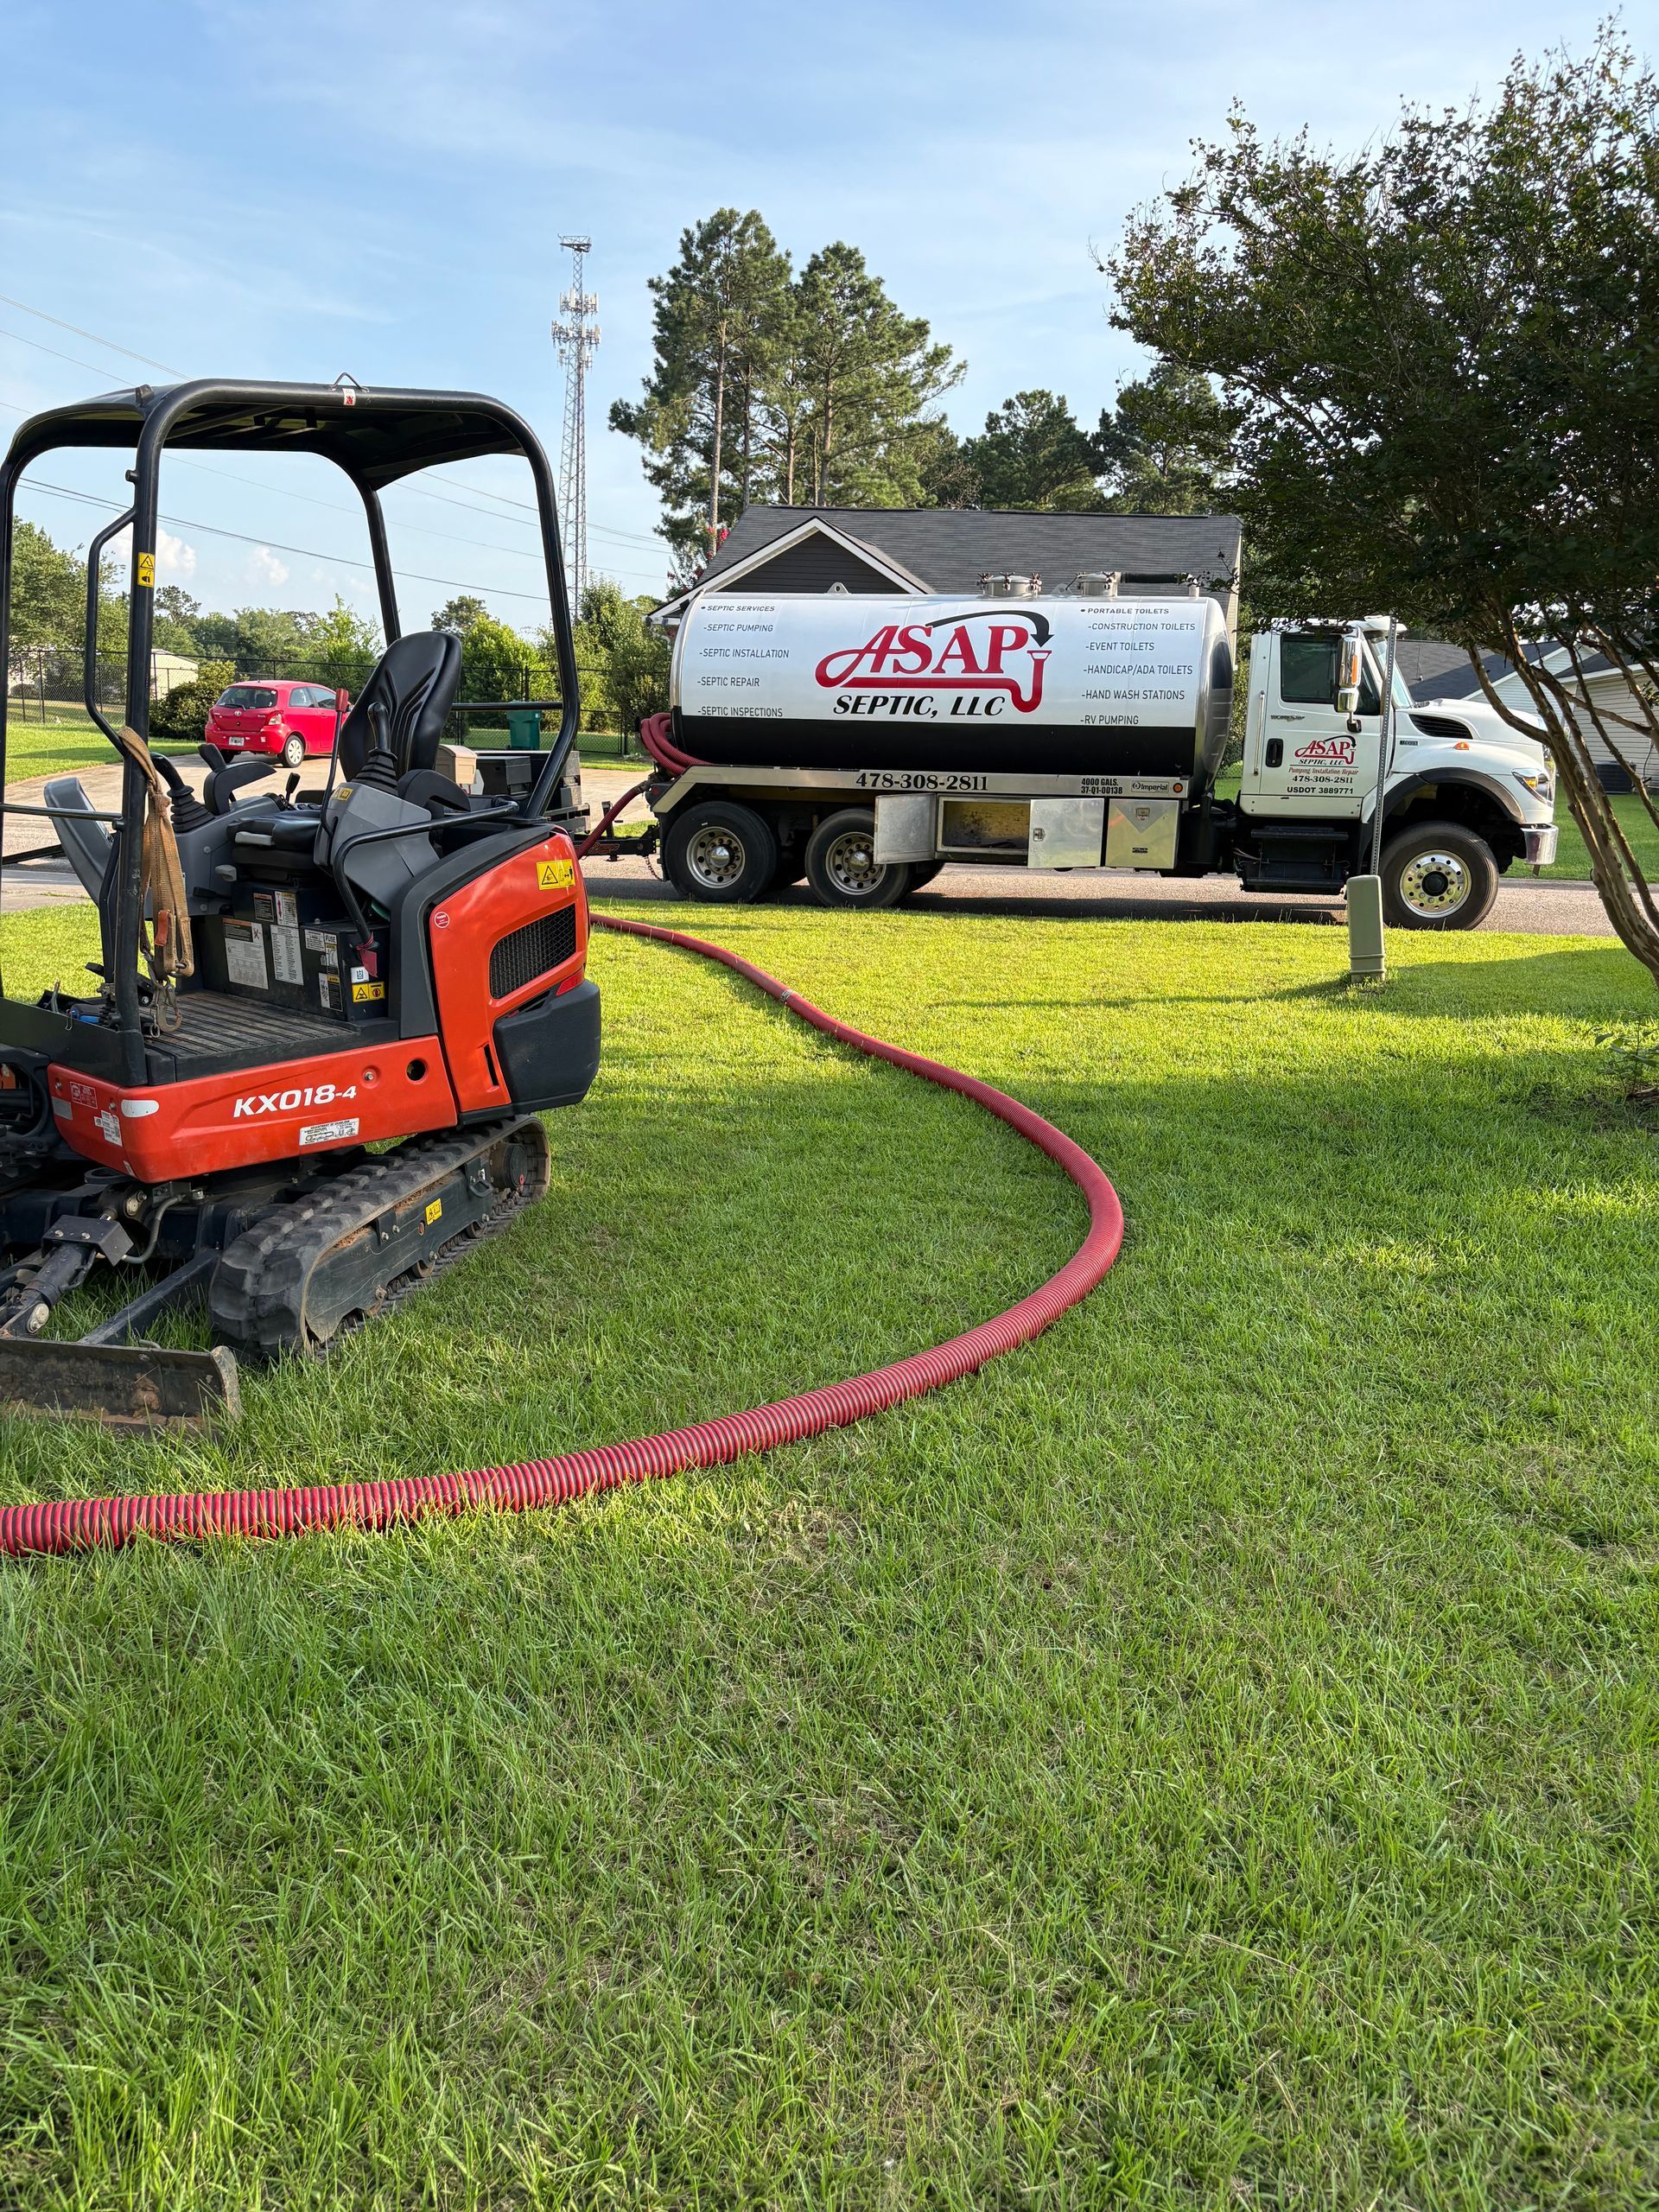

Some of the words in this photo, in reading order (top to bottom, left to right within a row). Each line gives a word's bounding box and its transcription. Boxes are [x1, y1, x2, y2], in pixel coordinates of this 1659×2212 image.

[1120, 642, 1154, 651] TOILETS
[733, 649, 790, 658] INSTALLATION
[815, 625, 1029, 688] ASAP
[1084, 664, 1155, 676] -HANDICAP/ADA
[1158, 664, 1193, 675] TOILETS
[730, 677, 760, 687] REPAIR
[1081, 690, 1111, 700] -HAND
[1113, 690, 1140, 700] WASH
[1141, 690, 1185, 700] STATIONS
[833, 695, 938, 718] SEPTIC,
[950, 696, 1006, 716] LLC
[730, 707, 783, 717] INSPECTIONS
[1098, 715, 1139, 725] PUMPING
[1294, 740, 1351, 758] ASAP
[855, 772, 988, 791] 478-308-2811
[1292, 775, 1353, 784] 478-308-2811
[1141, 783, 1168, 792] Imperial
[233, 1084, 357, 1118] KX018-4
